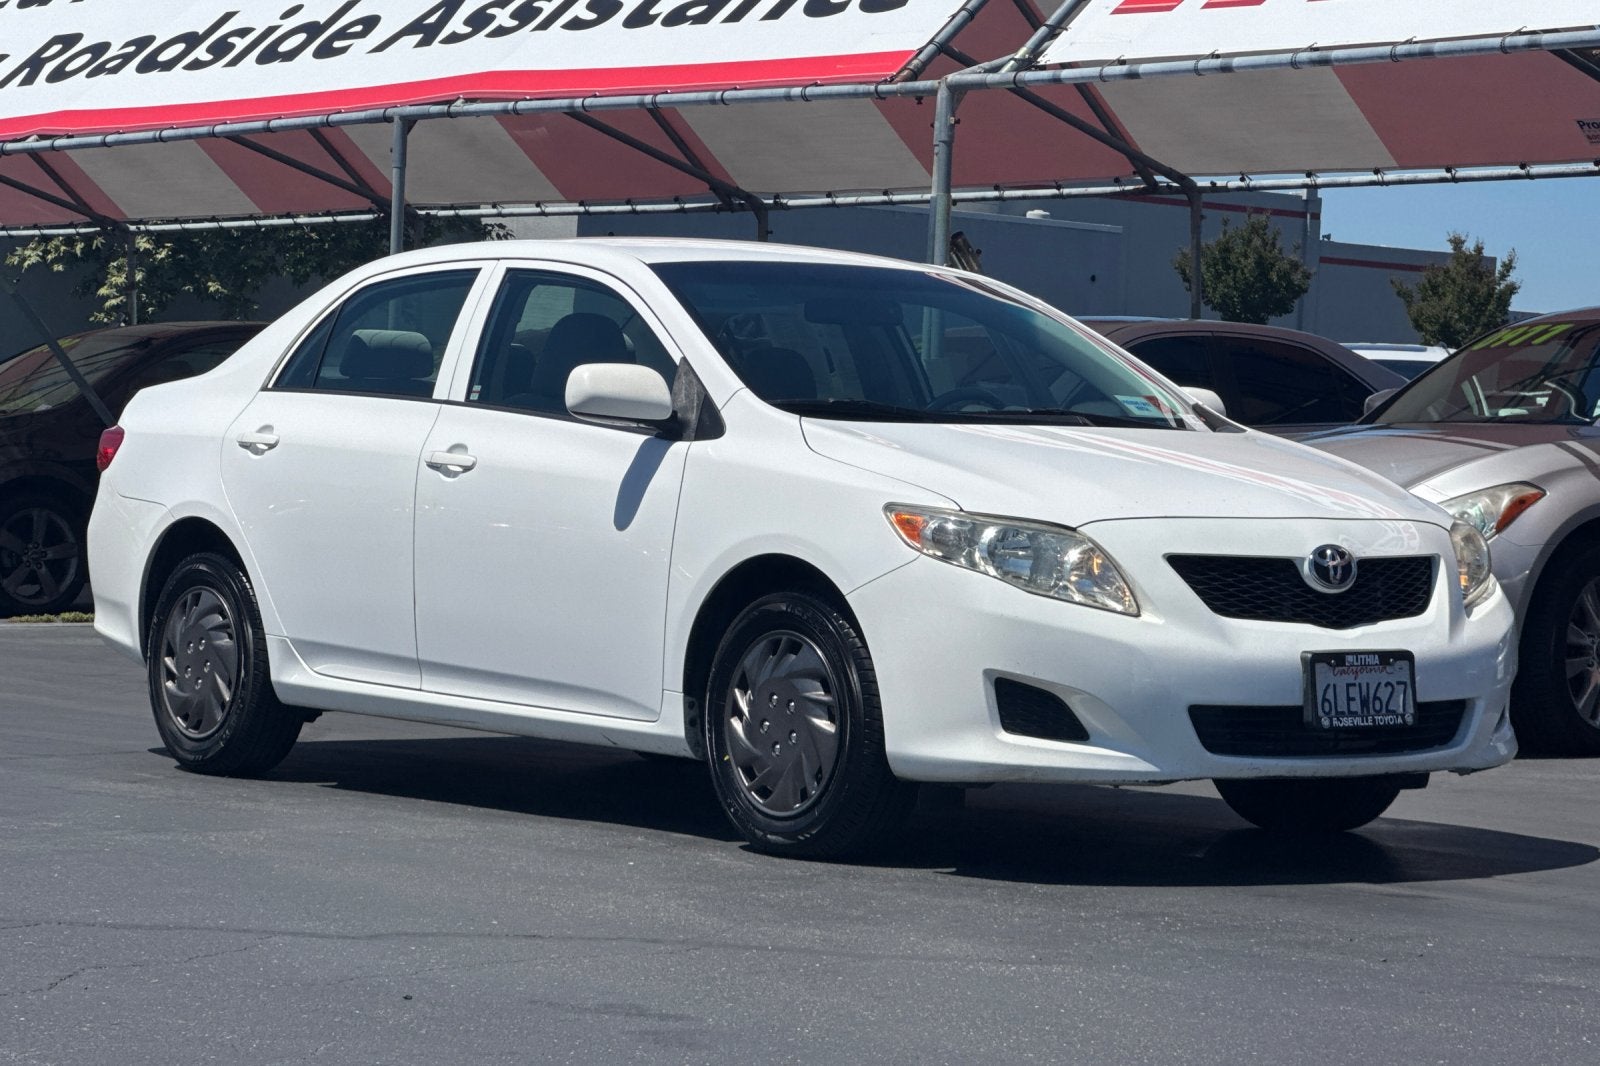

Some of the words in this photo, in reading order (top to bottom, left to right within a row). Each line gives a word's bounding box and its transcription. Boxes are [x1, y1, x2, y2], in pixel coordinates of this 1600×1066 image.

[0, 0, 382, 89] Roadside
[1354, 655, 1380, 665] LITHIA
[1321, 682, 1407, 716] 6LEW627
